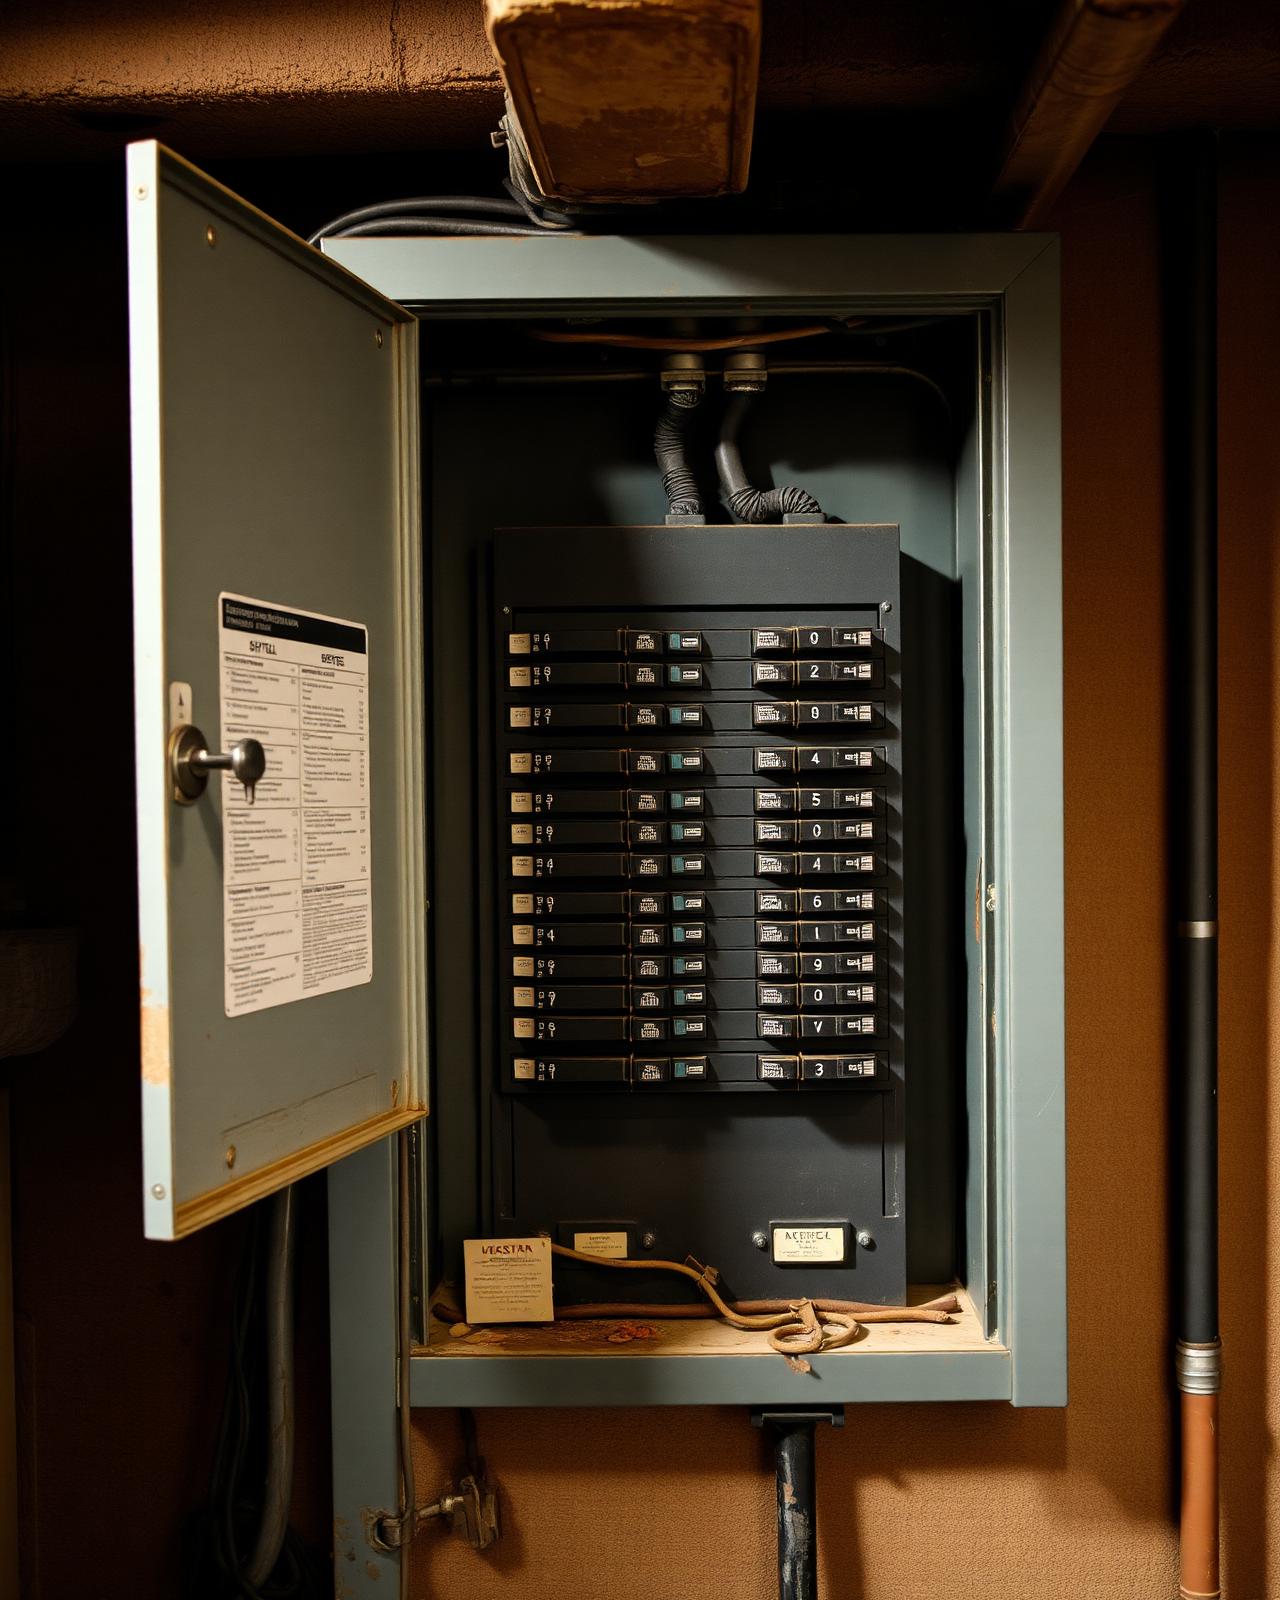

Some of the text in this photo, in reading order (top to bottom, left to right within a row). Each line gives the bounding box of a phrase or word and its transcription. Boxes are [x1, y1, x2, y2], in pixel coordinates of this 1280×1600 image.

[809, 665, 820, 678] 2
[810, 752, 821, 765] 4
[811, 792, 821, 807] 5
[812, 857, 821, 871] 4
[813, 895, 822, 908] 6
[813, 958, 823, 971] 9
[814, 1063, 824, 1077] 3
